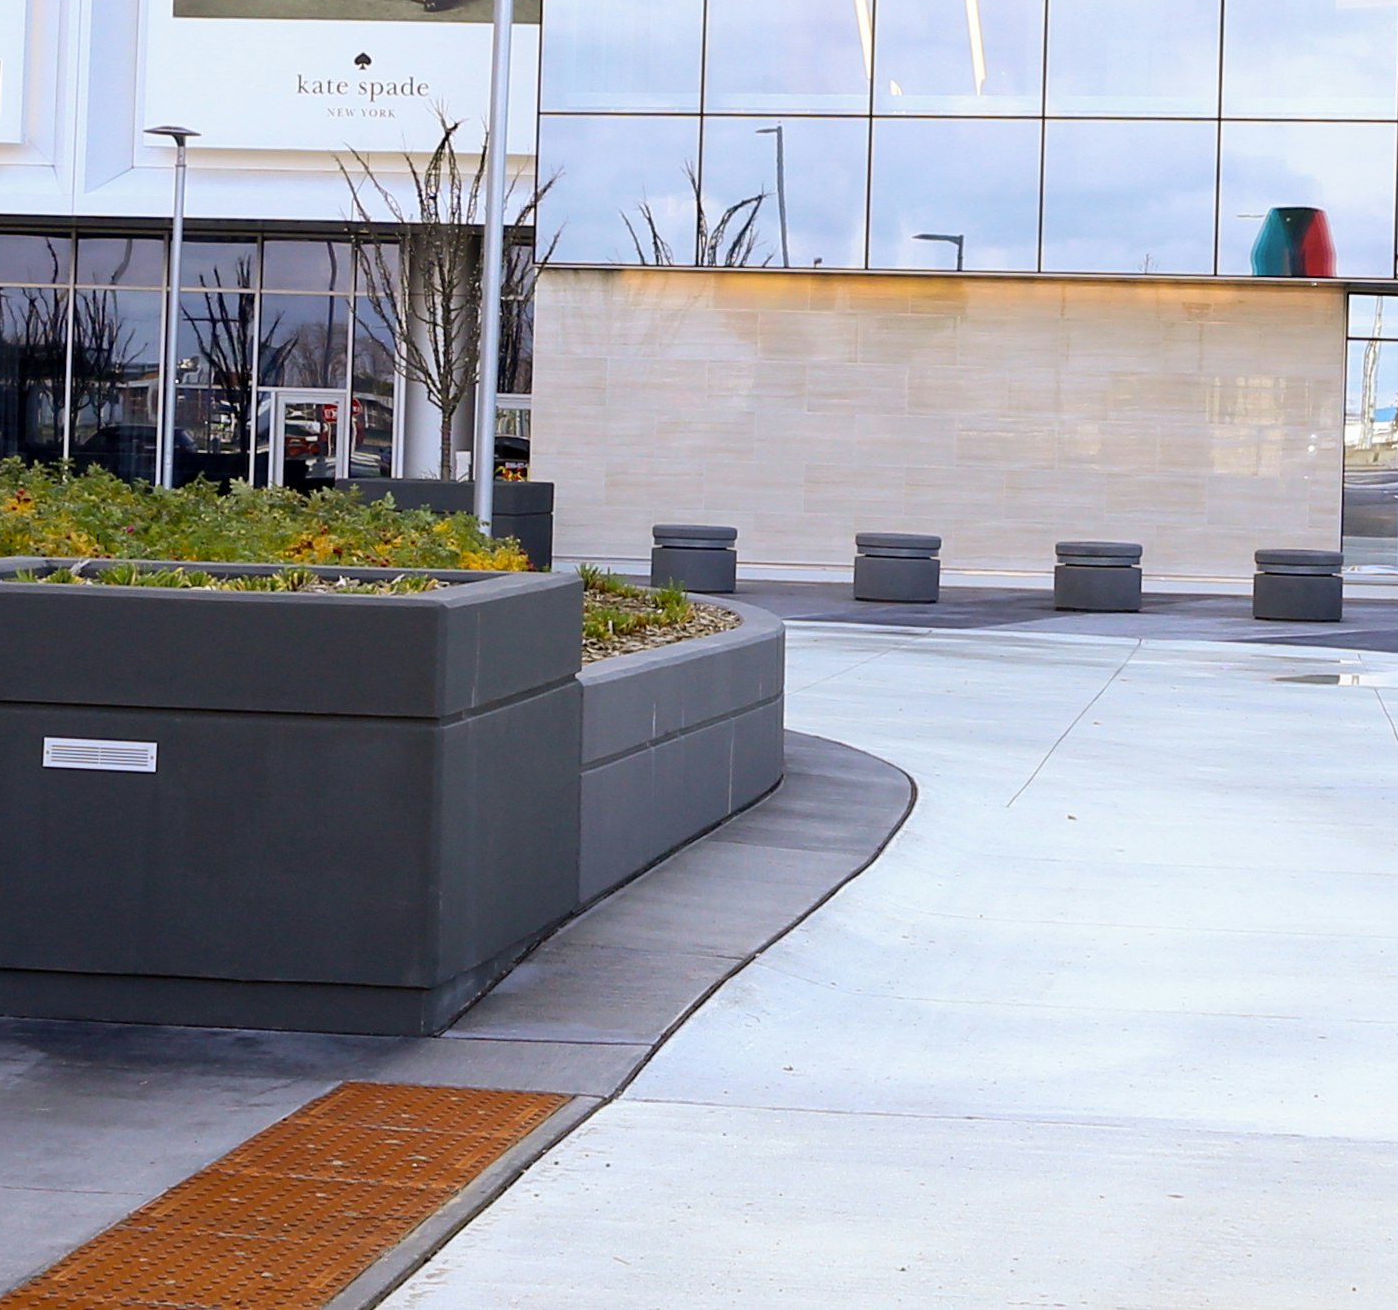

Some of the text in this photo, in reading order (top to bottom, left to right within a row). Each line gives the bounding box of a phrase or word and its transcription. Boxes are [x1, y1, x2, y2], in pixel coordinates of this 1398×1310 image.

[296, 74, 430, 103] kate spade
[326, 107, 397, 119] NEW YORK
